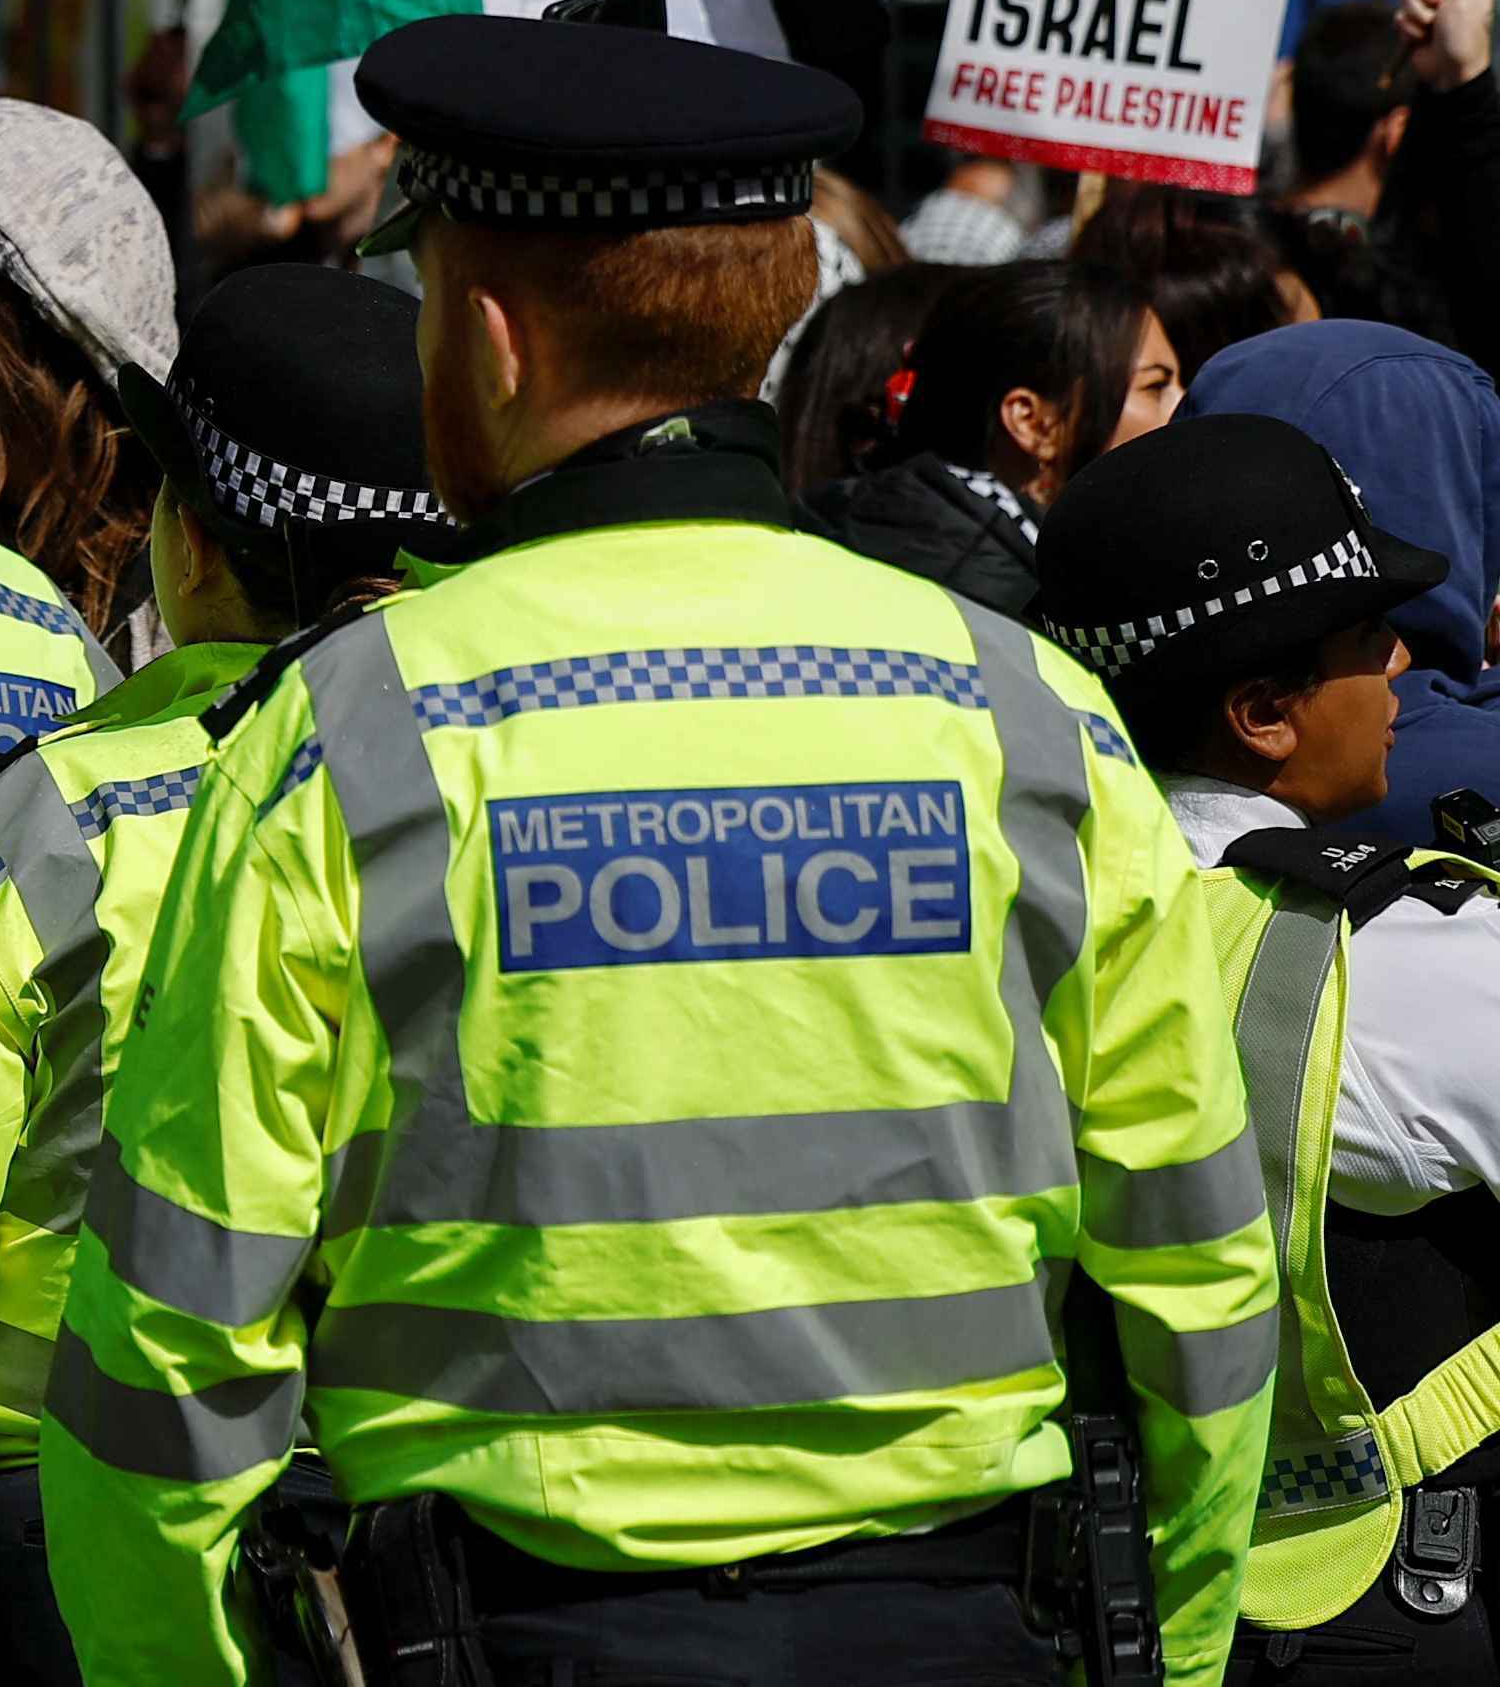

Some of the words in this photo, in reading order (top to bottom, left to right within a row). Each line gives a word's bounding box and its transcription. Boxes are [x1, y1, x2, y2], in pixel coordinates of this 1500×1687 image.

[948, 63, 1045, 113] FREE
[1056, 78, 1246, 139] PALESTINE
[500, 793, 958, 855] METROPOLITAN
[505, 848, 962, 959] POLICE
